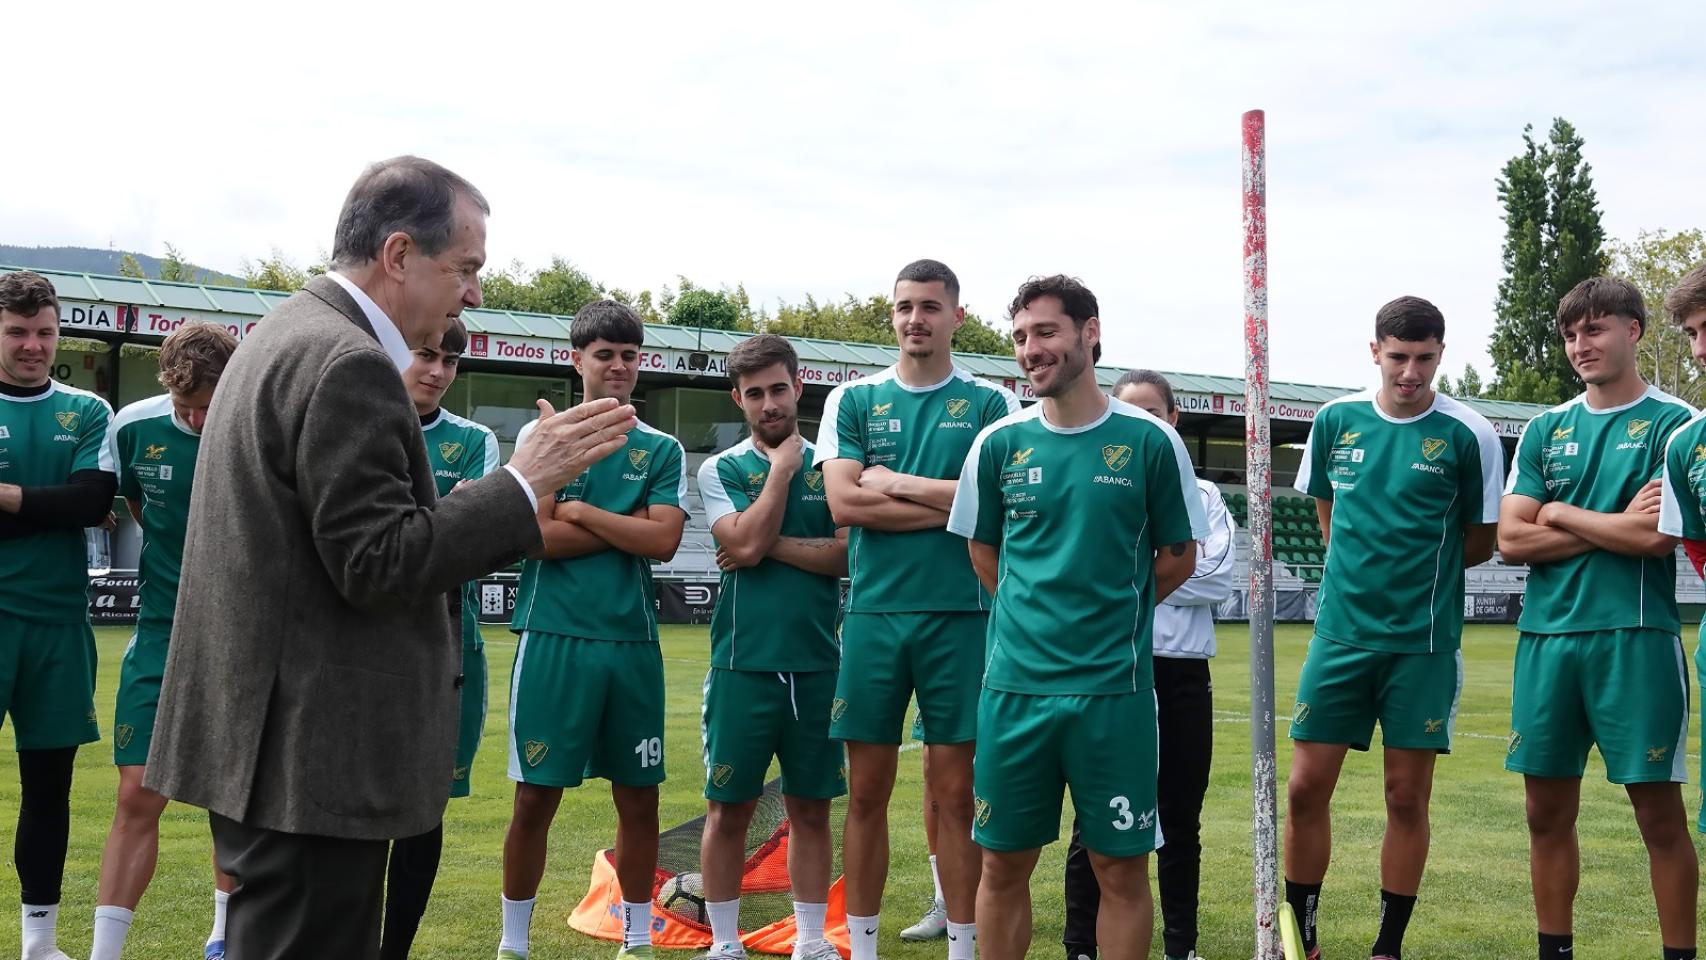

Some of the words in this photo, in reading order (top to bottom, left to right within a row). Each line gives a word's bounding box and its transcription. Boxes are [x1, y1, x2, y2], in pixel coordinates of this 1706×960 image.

[60, 305, 110, 327] DÍA
[496, 341, 545, 359] Todos
[551, 349, 570, 361] co
[639, 353, 666, 369] F.C.
[827, 371, 844, 382] co
[1279, 404, 1315, 419] Coruxo
[938, 421, 973, 429] ABANCA
[1616, 441, 1648, 450] ABANCA
[1411, 463, 1445, 475] ABANCA
[1093, 475, 1133, 488] ABANCA
[90, 577, 139, 587] Bocat
[1475, 596, 1496, 606] XUNTA
[1475, 606, 1484, 614] DE
[1484, 605, 1507, 614] GALICIA
[635, 736, 662, 768] 19
[1109, 795, 1135, 831] 3
